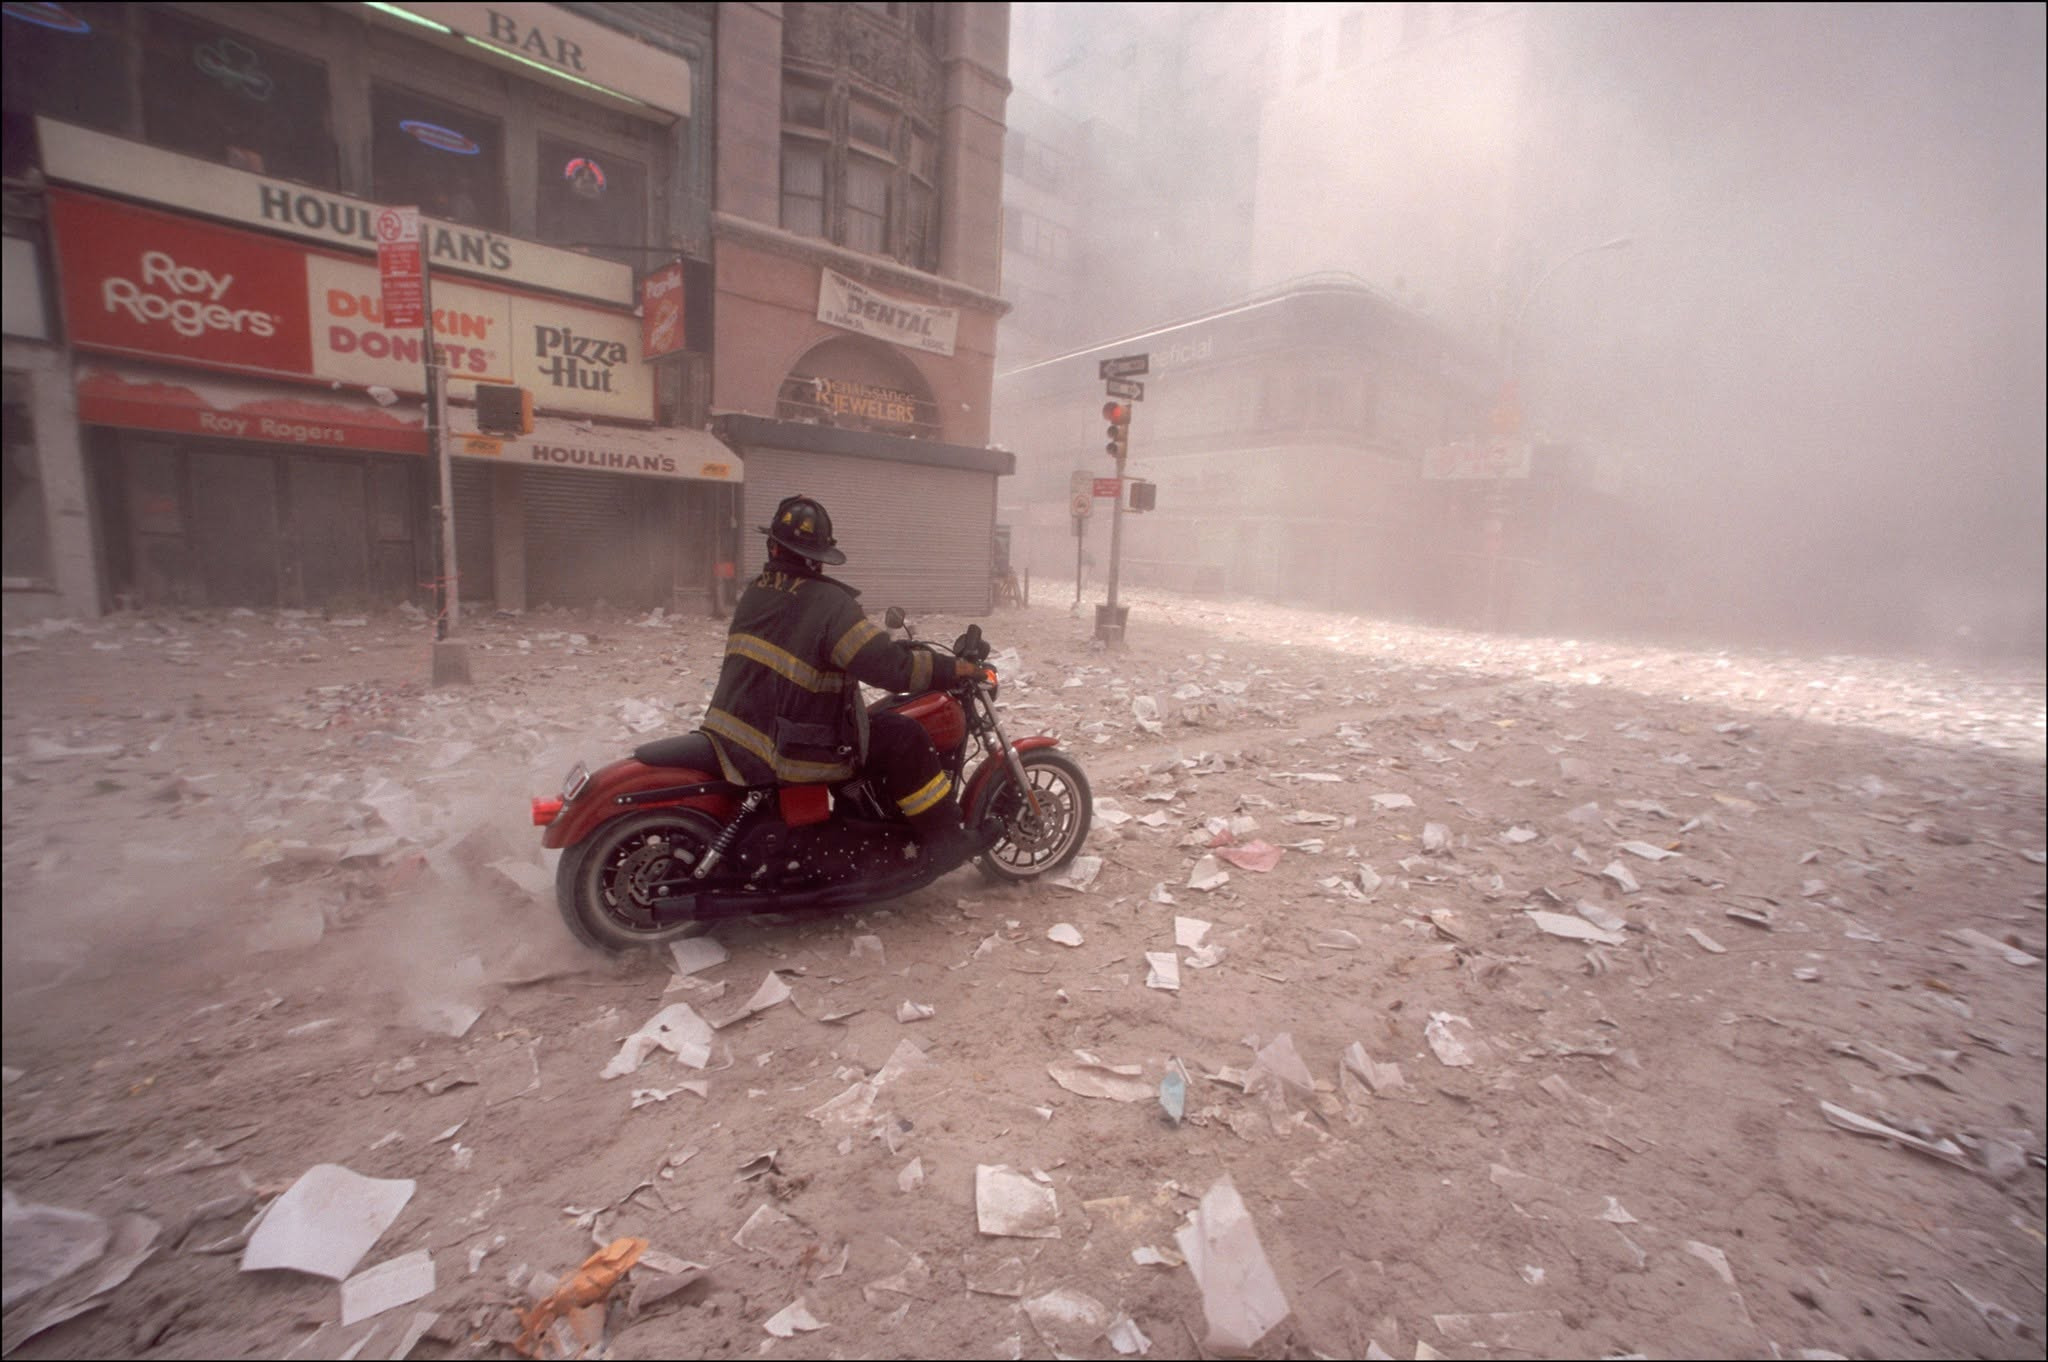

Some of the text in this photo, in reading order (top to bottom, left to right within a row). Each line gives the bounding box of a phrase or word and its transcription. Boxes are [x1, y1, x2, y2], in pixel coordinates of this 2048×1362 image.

[486, 7, 586, 73] BAR
[258, 184, 513, 271] HOULAN'S
[141, 251, 233, 301] Roy
[103, 277, 275, 337] Rogers
[327, 289, 494, 341] DUKIN'
[847, 294, 933, 336] DENTAL
[535, 325, 627, 367] Pizza
[538, 356, 612, 392] Hut
[200, 412, 345, 443] Roy Rogers
[832, 393, 914, 423] JEWELERS
[532, 445, 677, 473] HOULIHAN'S
